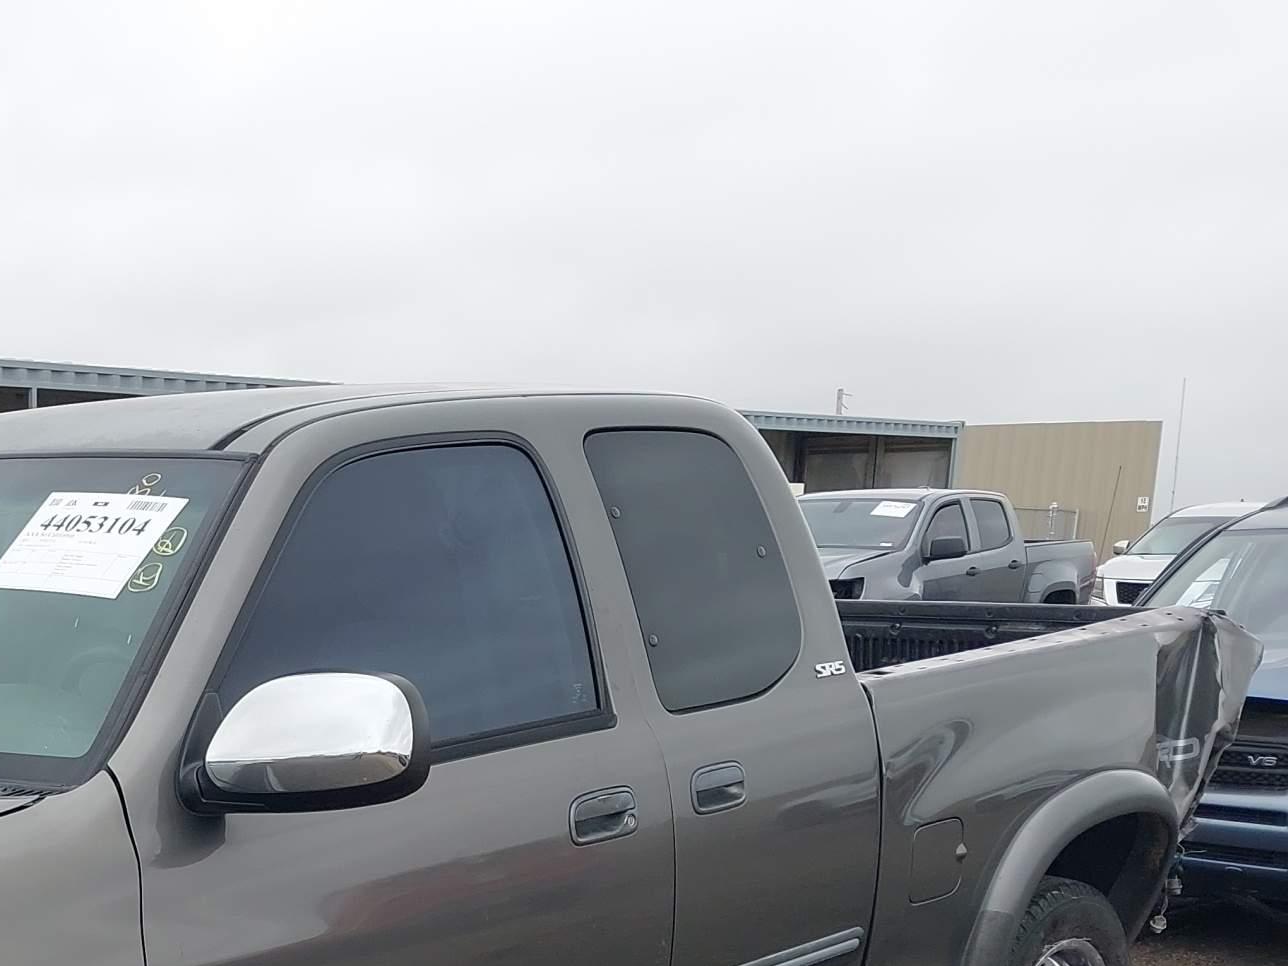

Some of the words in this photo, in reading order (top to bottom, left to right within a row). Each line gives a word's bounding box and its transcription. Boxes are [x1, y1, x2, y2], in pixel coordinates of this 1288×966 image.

[39, 514, 153, 536] 44053104
[815, 660, 846, 678] SR5
[1247, 755, 1278, 766] V6
